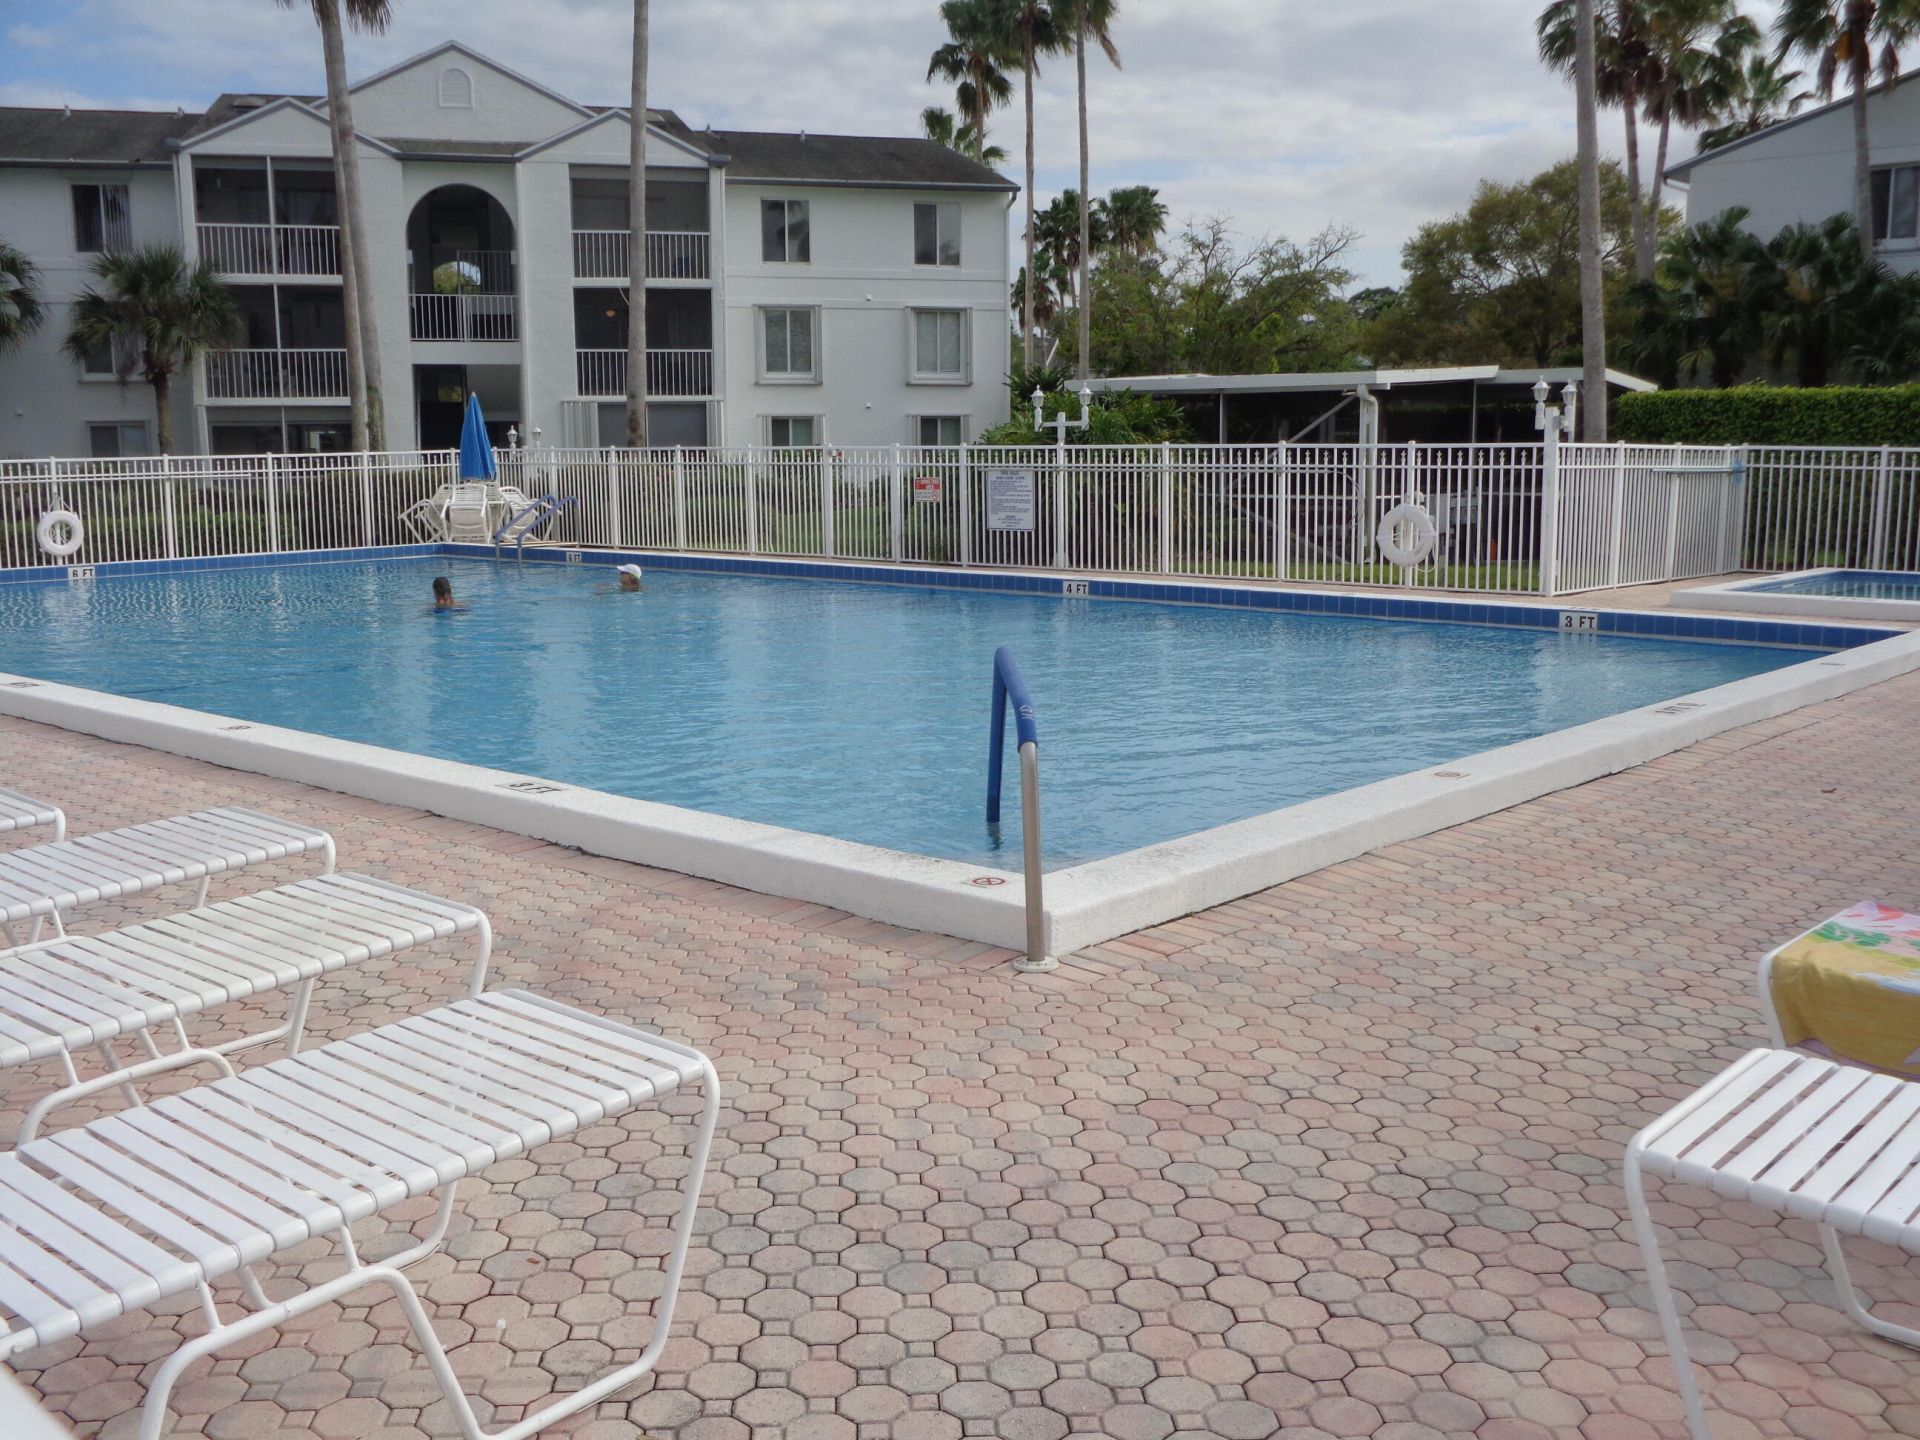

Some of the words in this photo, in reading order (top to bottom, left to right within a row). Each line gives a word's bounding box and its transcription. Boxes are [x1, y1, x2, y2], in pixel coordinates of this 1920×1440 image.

[82, 568, 94, 577] FT
[1066, 583, 1073, 594] 4
[1076, 583, 1088, 595] FT
[1565, 615, 1573, 628] 3
[1579, 615, 1595, 629] FT
